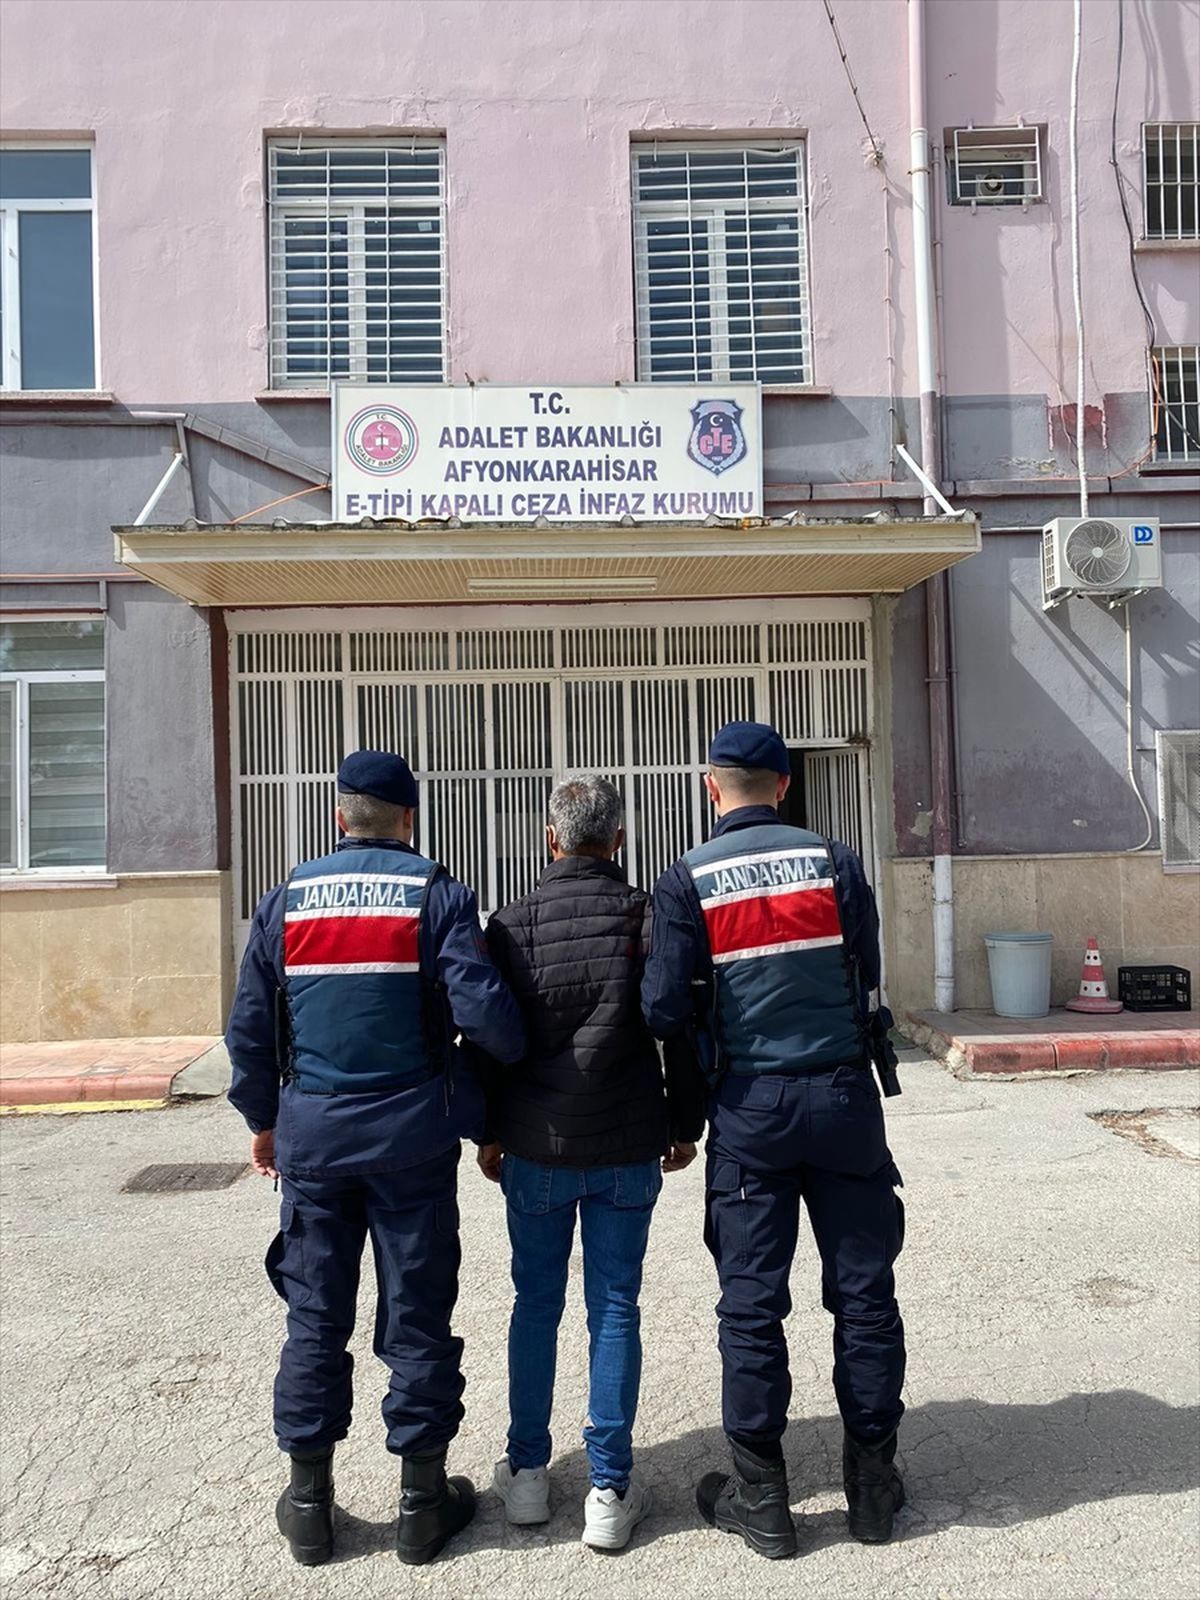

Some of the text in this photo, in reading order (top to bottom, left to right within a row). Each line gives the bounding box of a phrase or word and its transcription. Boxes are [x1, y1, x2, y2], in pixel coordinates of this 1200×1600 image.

[529, 393, 570, 415] T.C.
[438, 420, 661, 448] ADALET BAKANLIĞI
[444, 459, 658, 482] AFYONKARAHİSAR
[347, 488, 753, 517] E-TİPİ KAPALI CEZA İNFAZ KURUMU
[710, 856, 819, 896] JANDARMA
[296, 881, 407, 911] JANDARMA
